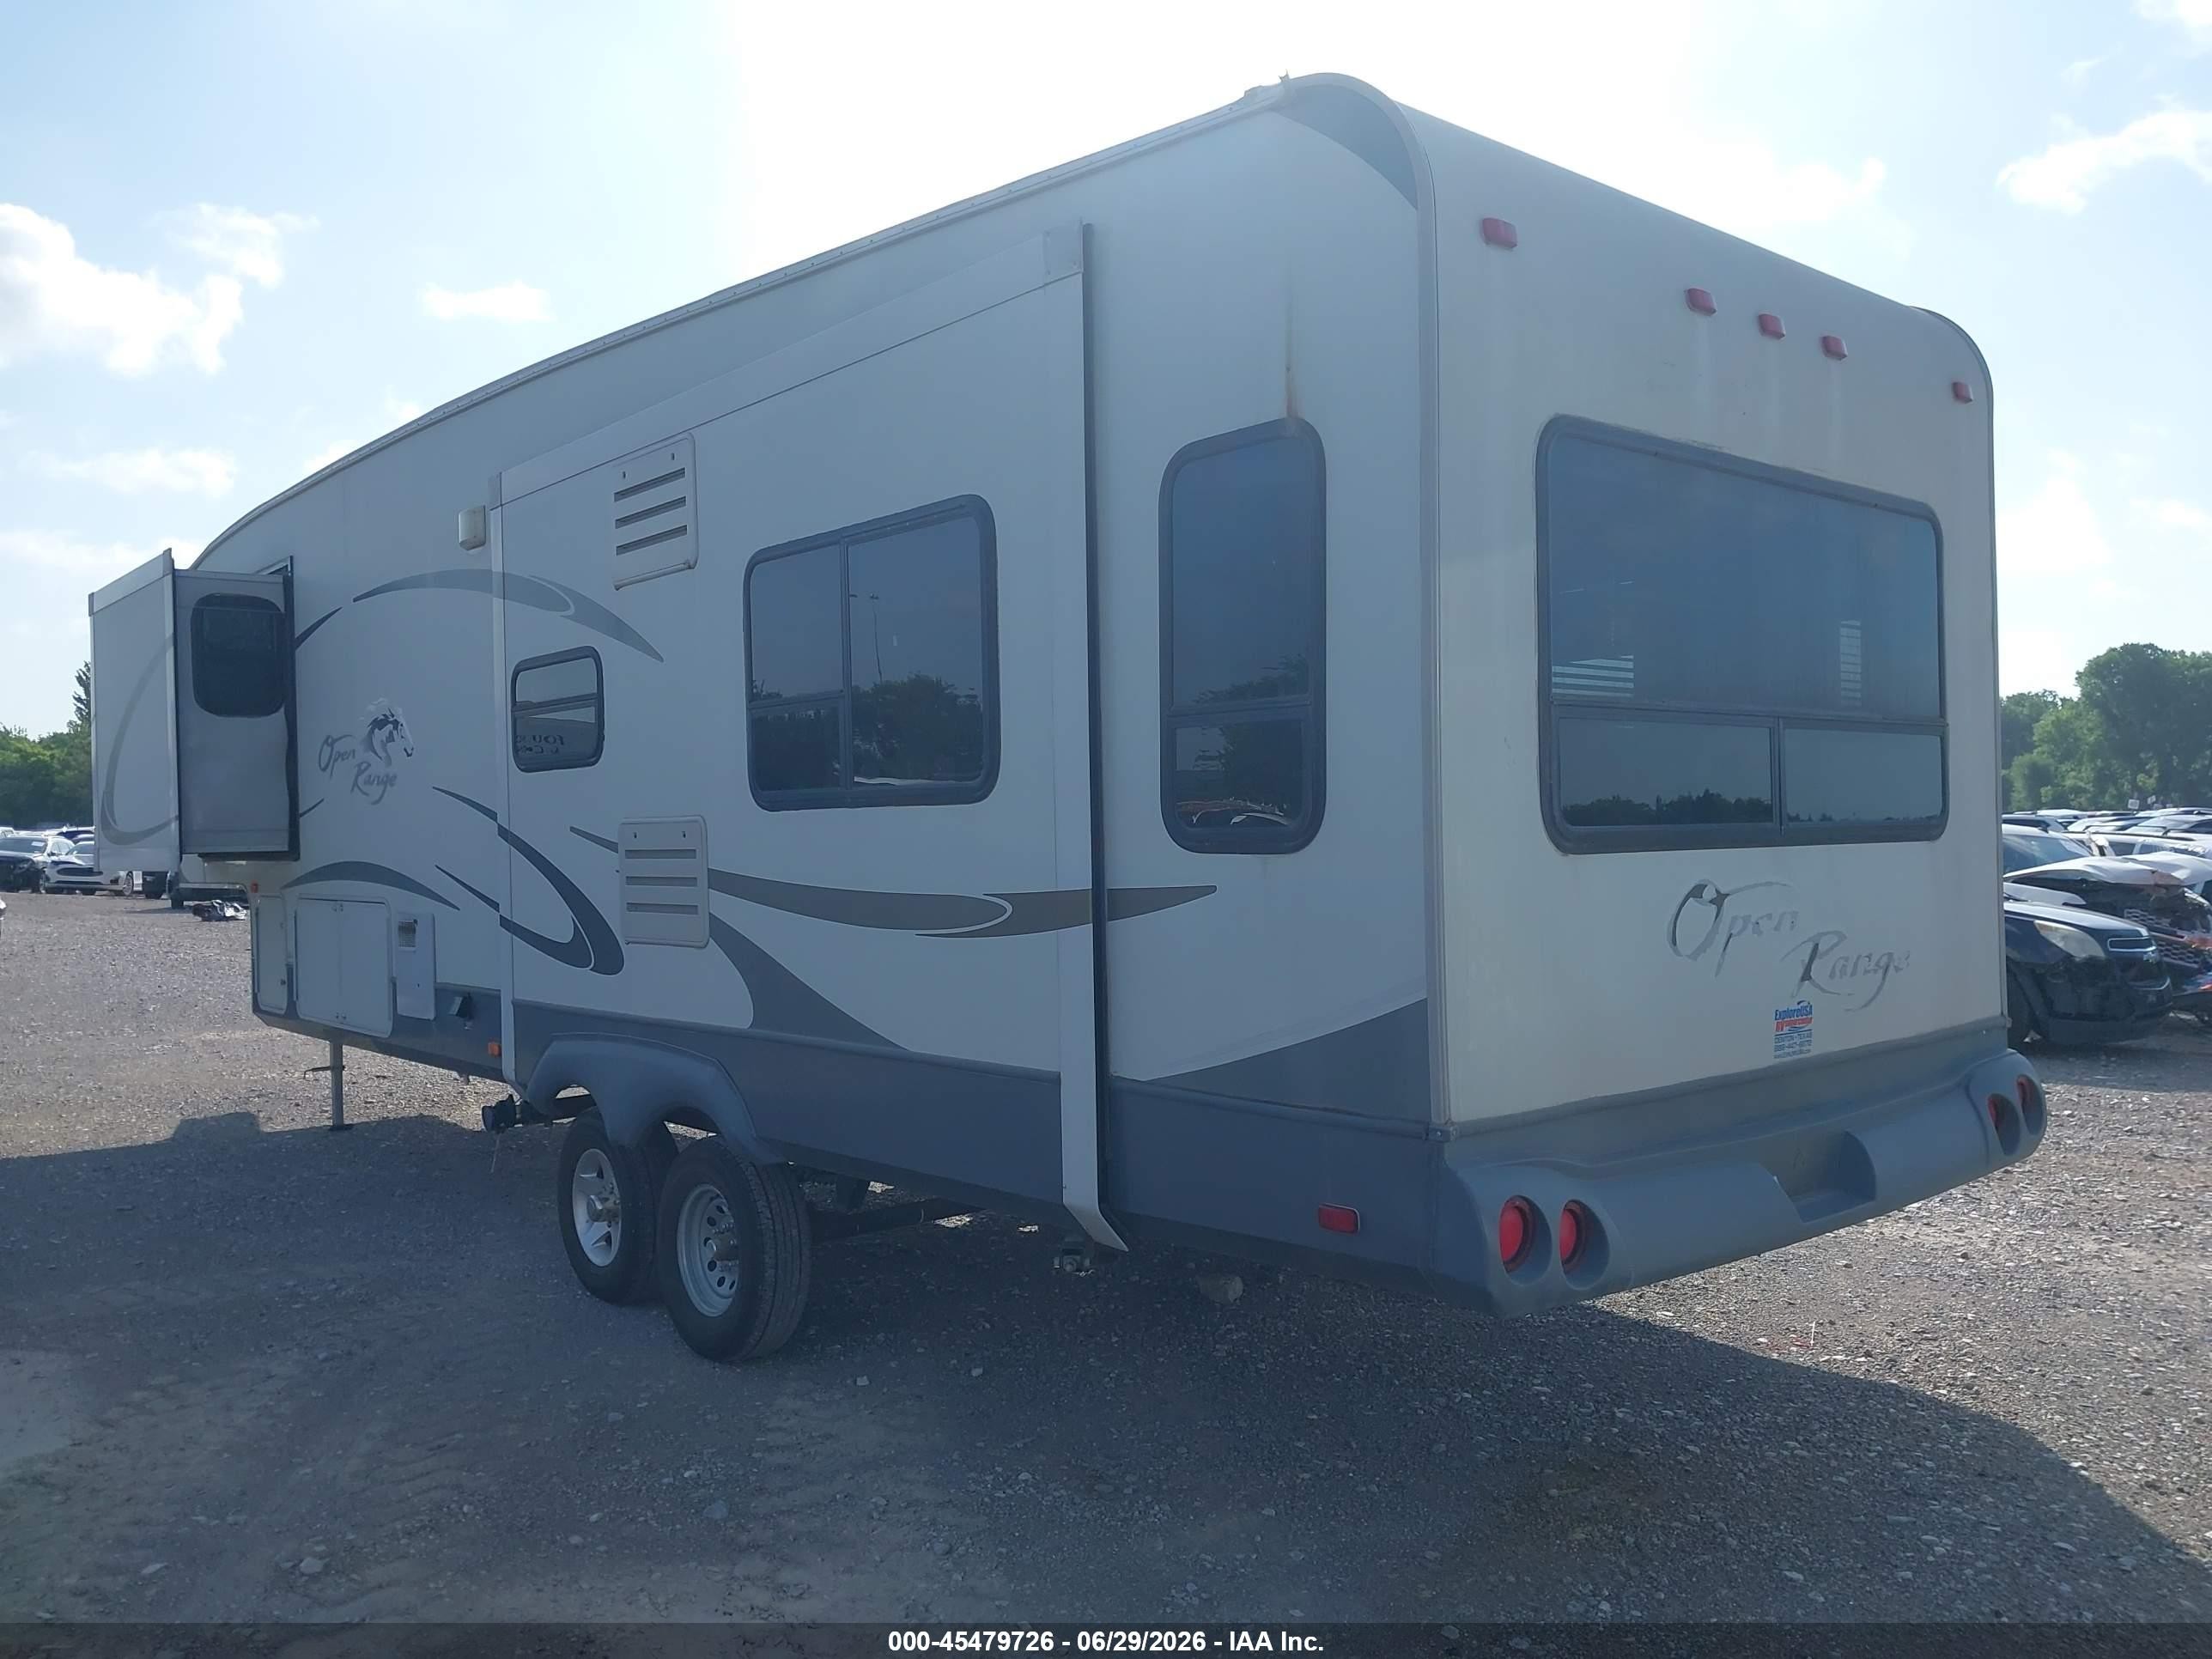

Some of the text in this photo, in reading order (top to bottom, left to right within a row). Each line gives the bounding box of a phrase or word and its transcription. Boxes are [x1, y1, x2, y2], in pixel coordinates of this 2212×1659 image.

[319, 734, 356, 781] Open
[350, 761, 397, 805] Range
[1668, 878, 1800, 977] Open
